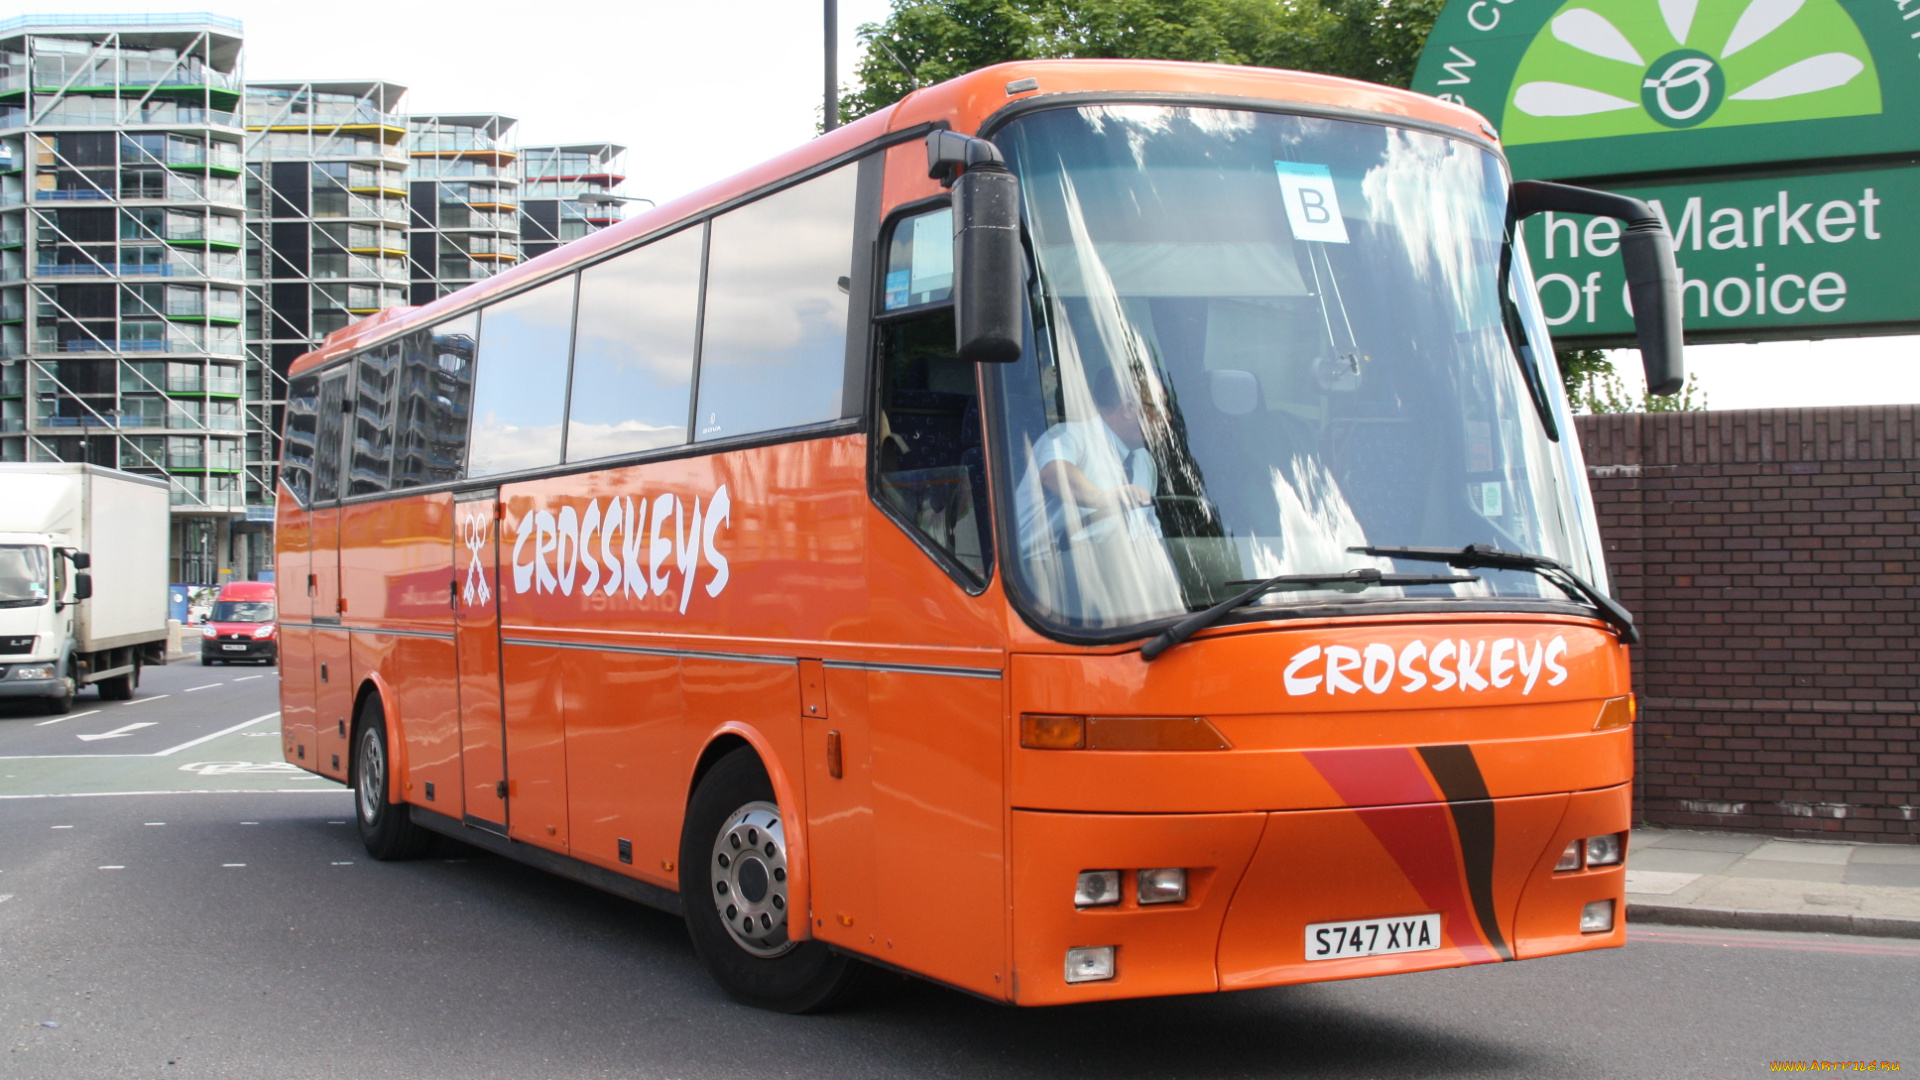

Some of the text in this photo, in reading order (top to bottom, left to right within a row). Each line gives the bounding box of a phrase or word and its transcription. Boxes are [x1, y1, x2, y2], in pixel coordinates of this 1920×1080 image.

[1298, 187, 1331, 224] B
[1520, 187, 1882, 260] he Market
[1535, 271, 1602, 326] Of
[512, 483, 731, 616] CROSSKEYS
[1283, 635, 1568, 696] CROSSKEYS
[1316, 919, 1431, 955] S747 XYA
